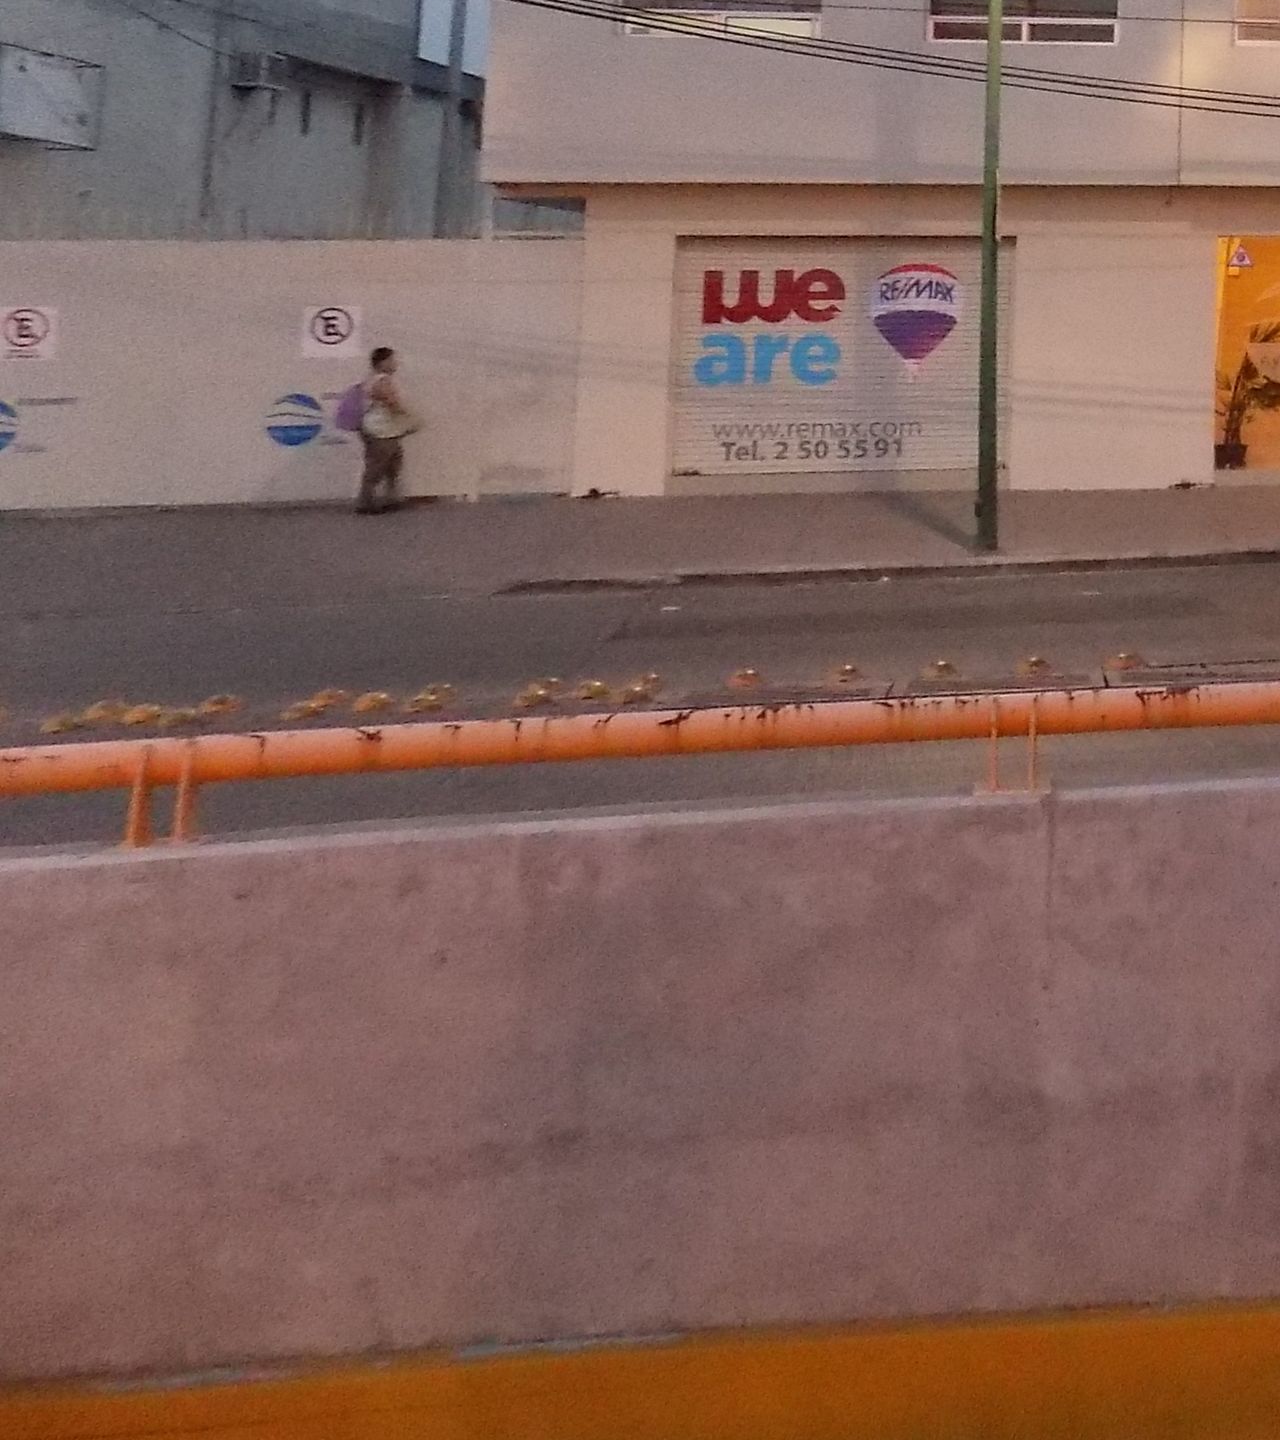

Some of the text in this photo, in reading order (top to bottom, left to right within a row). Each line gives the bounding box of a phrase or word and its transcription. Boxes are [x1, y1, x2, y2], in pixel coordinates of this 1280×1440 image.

[702, 268, 846, 324] we
[880, 277, 955, 303] RE/MAX
[694, 331, 842, 388] are
[712, 419, 922, 440] www.remax.com
[720, 441, 766, 461] Tel.
[773, 441, 789, 460] 2
